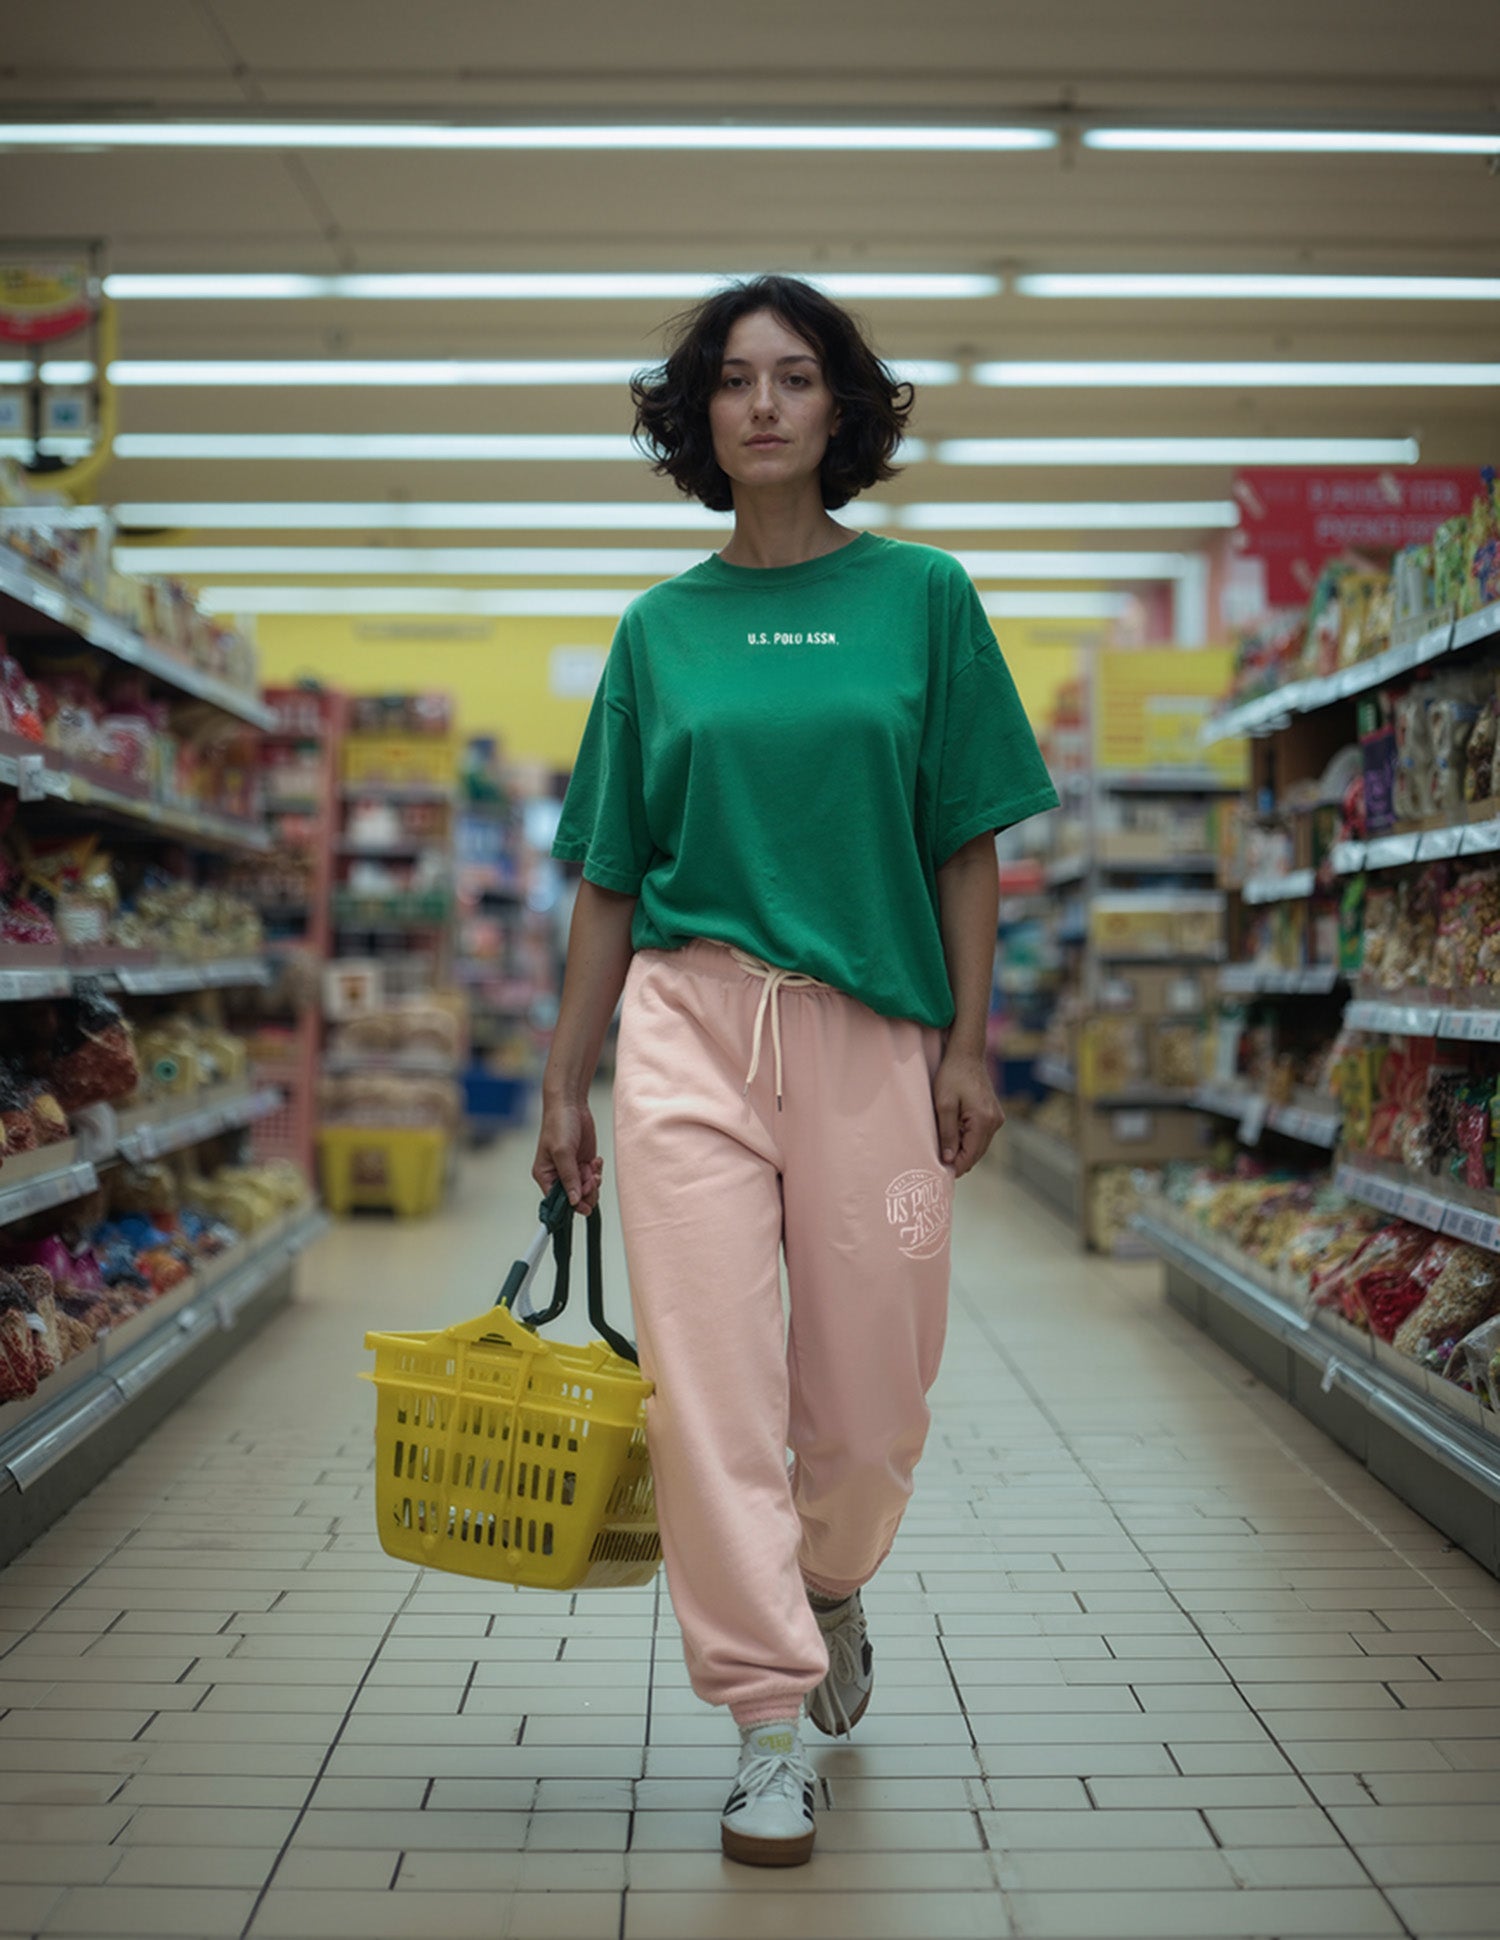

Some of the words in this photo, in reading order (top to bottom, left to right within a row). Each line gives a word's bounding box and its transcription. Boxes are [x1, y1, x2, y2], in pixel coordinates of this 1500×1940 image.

[747, 632, 771, 645] U.S.
[773, 632, 803, 645] POLO
[806, 632, 840, 646] ASSN.
